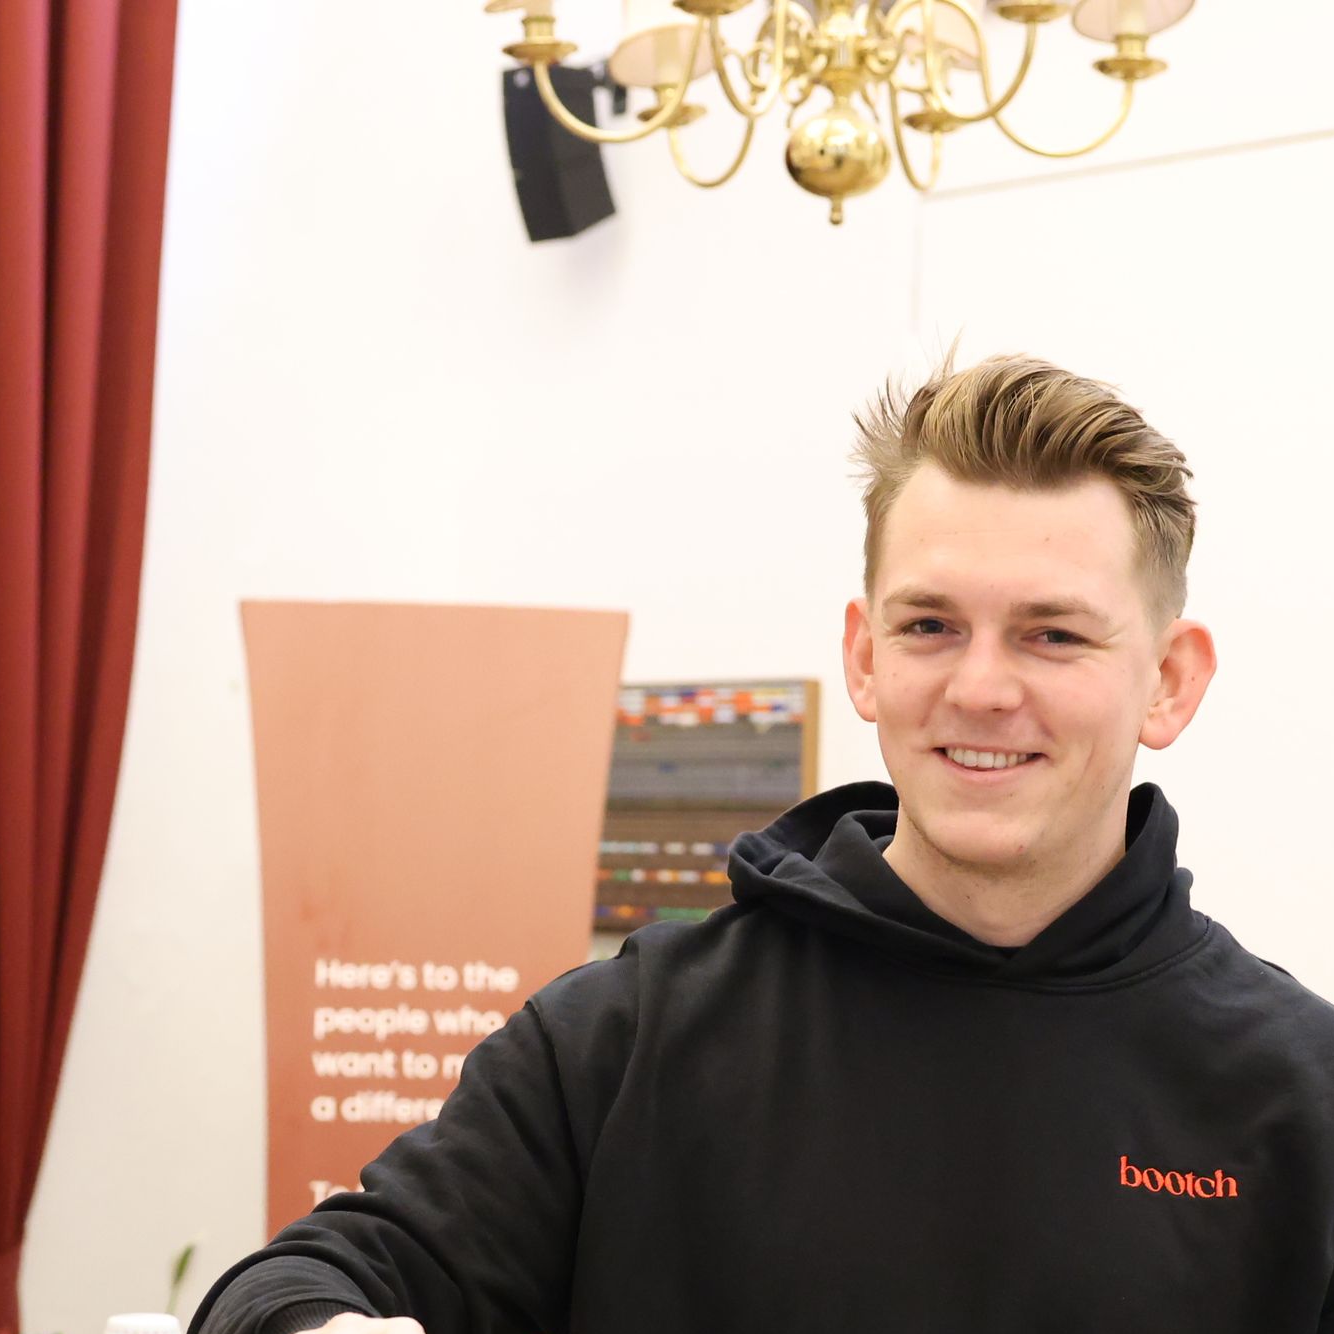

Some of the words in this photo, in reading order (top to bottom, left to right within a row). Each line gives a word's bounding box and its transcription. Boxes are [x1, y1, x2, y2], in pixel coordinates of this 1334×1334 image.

[315, 958, 417, 990] Here's
[422, 960, 459, 991] to
[463, 960, 520, 992] the
[313, 1003, 429, 1040] people
[432, 1004, 505, 1035] who
[312, 1049, 397, 1079] want
[402, 1048, 438, 1079] to
[310, 1095, 336, 1122] a
[340, 1090, 446, 1123] differe
[1120, 1155, 1238, 1198] bootch
